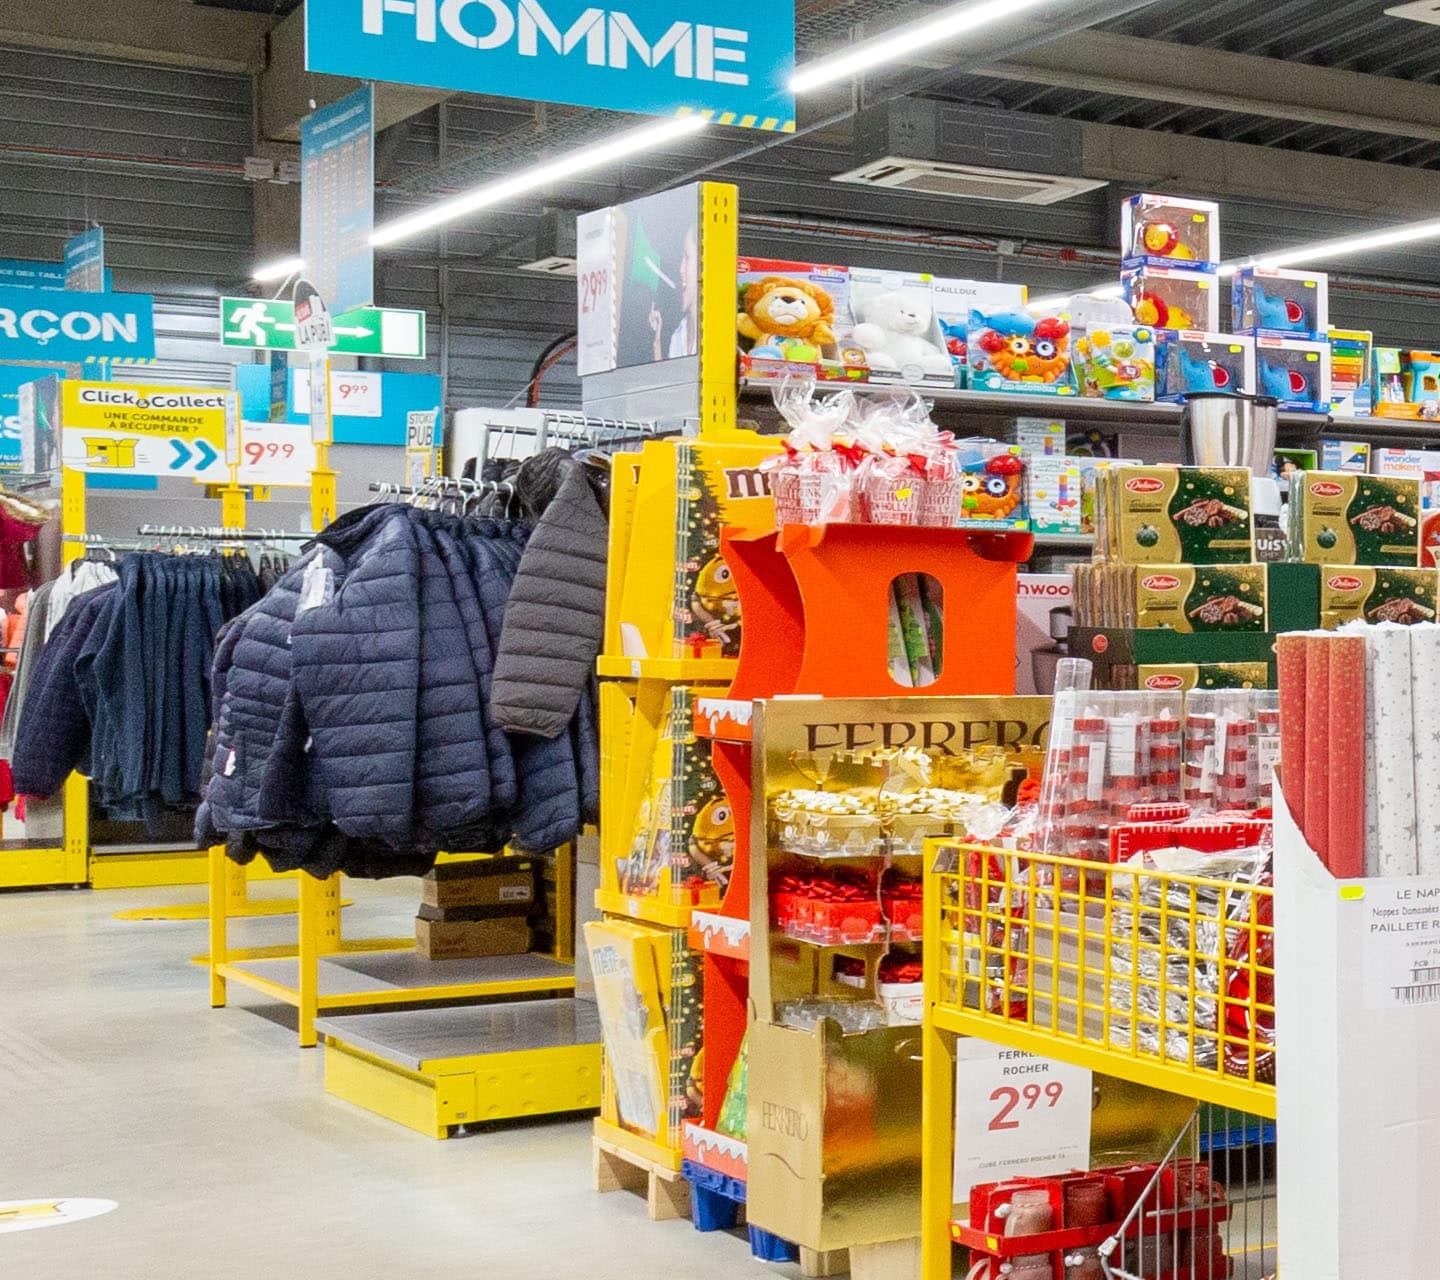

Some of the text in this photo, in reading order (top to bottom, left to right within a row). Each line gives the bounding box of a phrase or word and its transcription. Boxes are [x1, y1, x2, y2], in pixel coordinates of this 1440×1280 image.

[82, 390, 134, 404] Click
[152, 395, 225, 408] Collect
[104, 412, 203, 424] UNE COMMANDE
[1017, 581, 1073, 595] hwoo
[1397, 890, 1411, 900] LE
[1370, 921, 1429, 933] PAILLETE
[998, 1050, 1040, 1060] FERR
[1003, 1063, 1049, 1076] ROCHER
[988, 1081, 1063, 1131] 299
